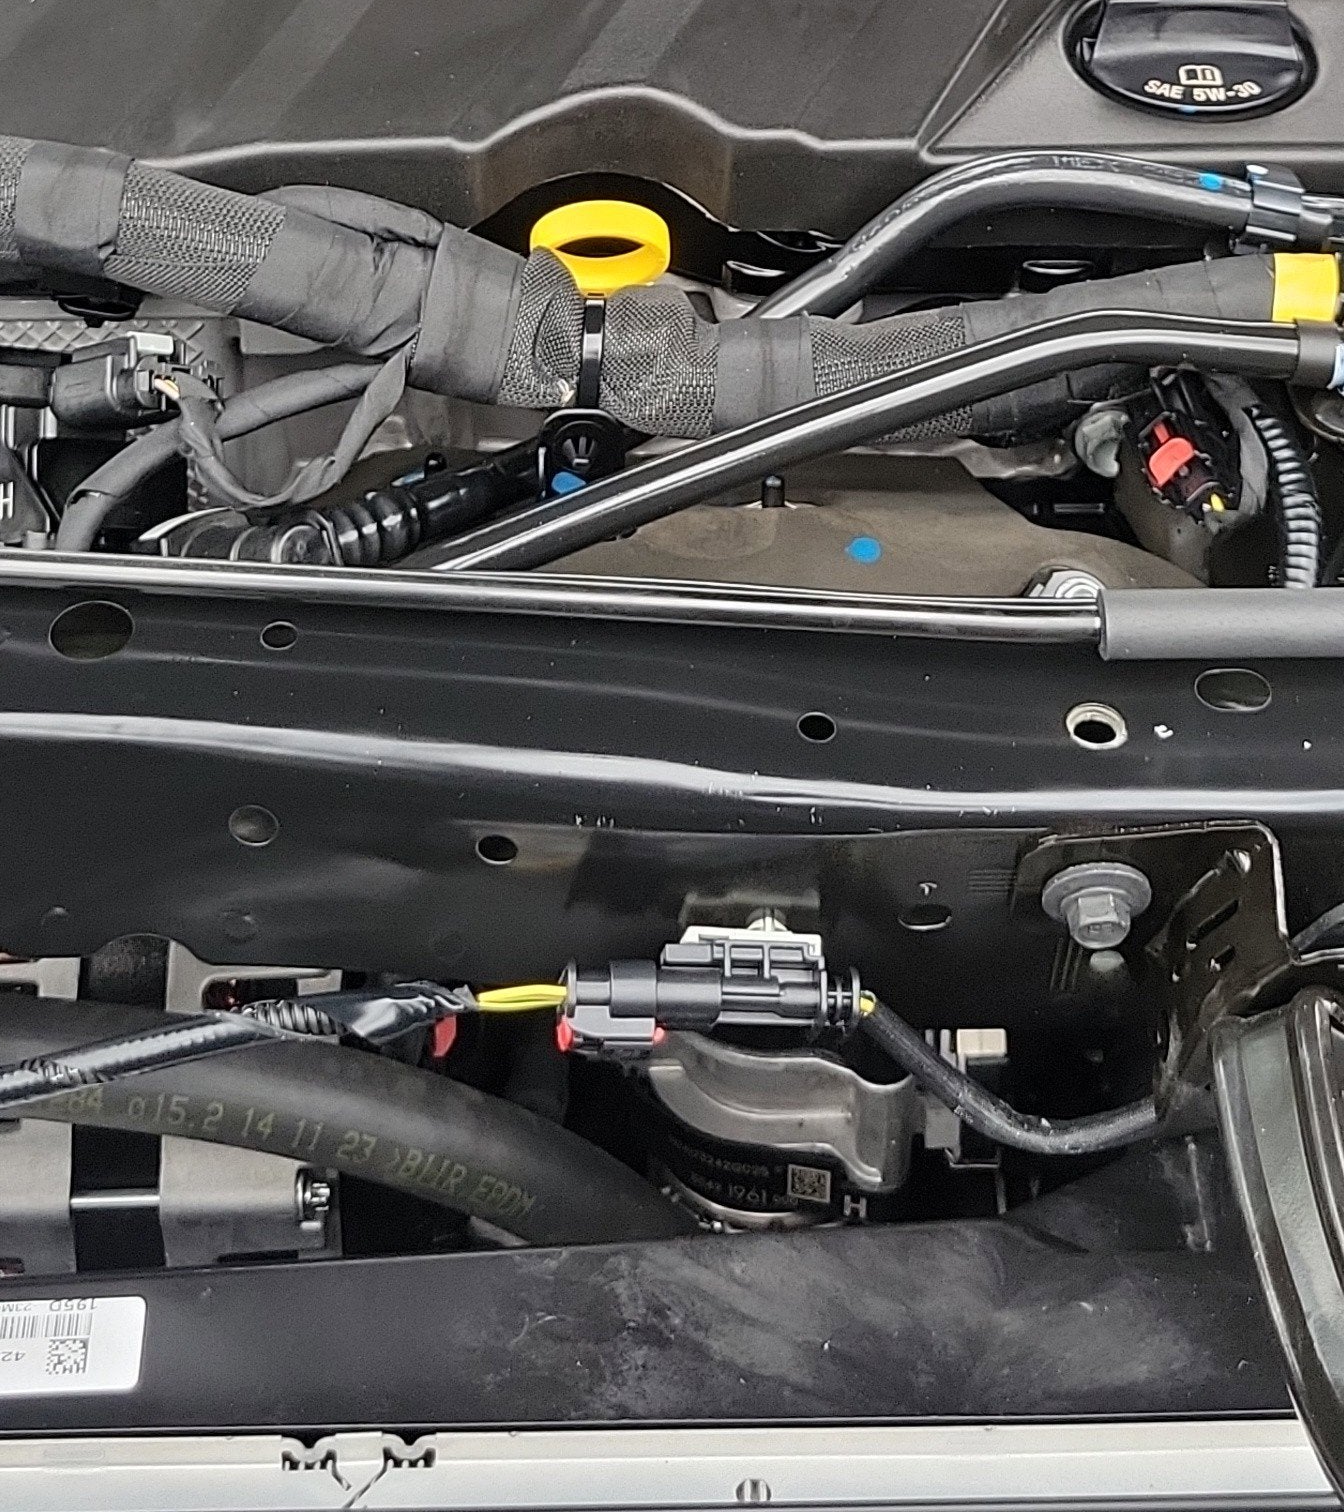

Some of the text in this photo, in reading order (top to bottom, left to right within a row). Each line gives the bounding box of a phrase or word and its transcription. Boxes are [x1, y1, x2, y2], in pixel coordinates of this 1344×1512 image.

[1144, 80, 1262, 101] SAE 5W-30
[240, 1107, 277, 1141] 14
[336, 1130, 378, 1164] 23
